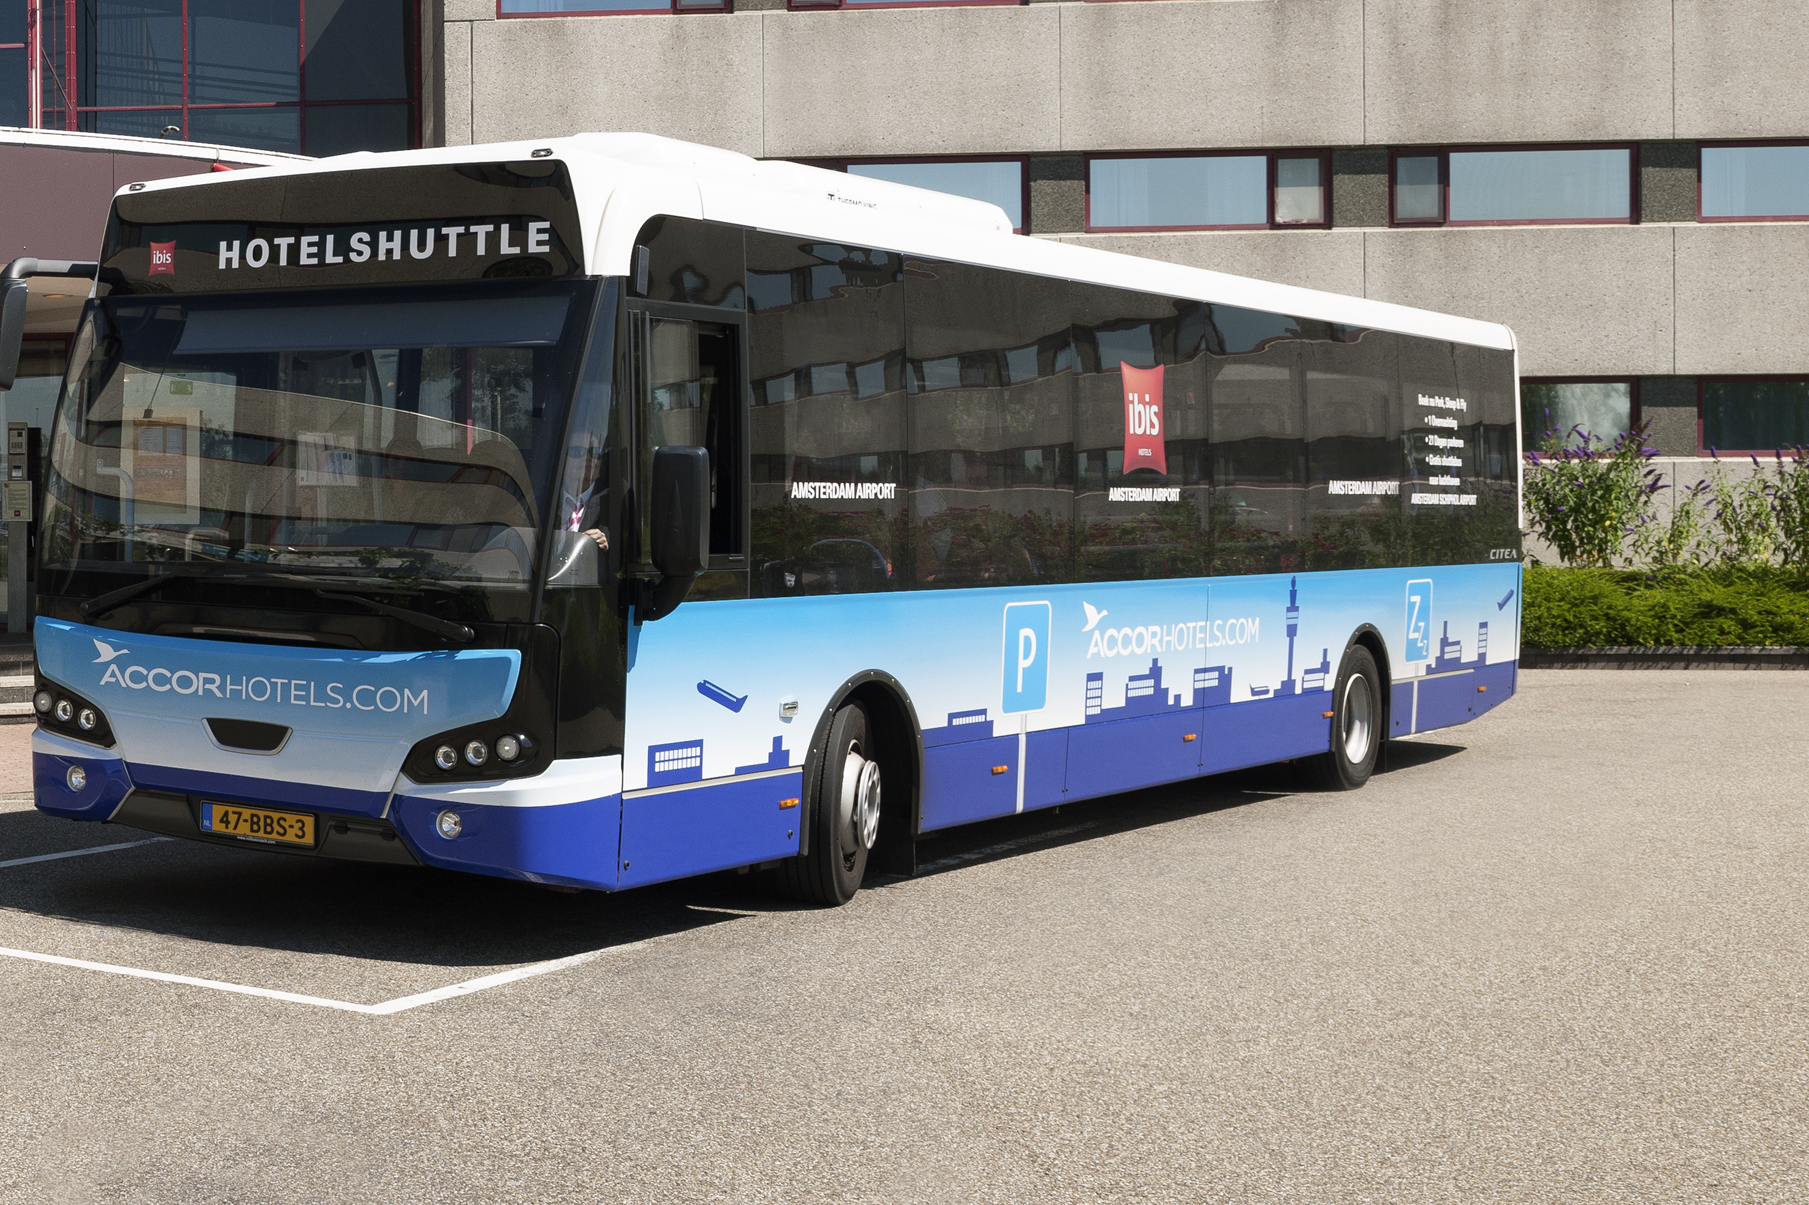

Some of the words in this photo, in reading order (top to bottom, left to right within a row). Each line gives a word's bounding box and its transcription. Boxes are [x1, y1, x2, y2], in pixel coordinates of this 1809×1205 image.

[218, 221, 551, 269] HOTELSHUTTLE
[153, 250, 172, 264] ibis
[1128, 392, 1159, 435] ibis
[1428, 435, 1434, 445] 21
[1138, 448, 1152, 456] HOTELS
[791, 482, 855, 499] AMSTERDAM
[856, 483, 896, 499] AIRPORT
[1109, 488, 1152, 501] AMSTERDAM
[1153, 488, 1180, 501] AIRPORT
[1328, 480, 1372, 494] AMSTERDAM
[1373, 481, 1400, 495] AIRPORT
[1411, 493, 1439, 504] AMSTERDAM
[1490, 548, 1517, 559] CITEA
[1086, 617, 1259, 659] ACCORHOTELS.COM
[1017, 628, 1037, 692] P
[99, 664, 428, 714] ACCORHOTELS.COM
[203, 819, 212, 827] NL
[219, 809, 306, 839] 47-BBS-3
